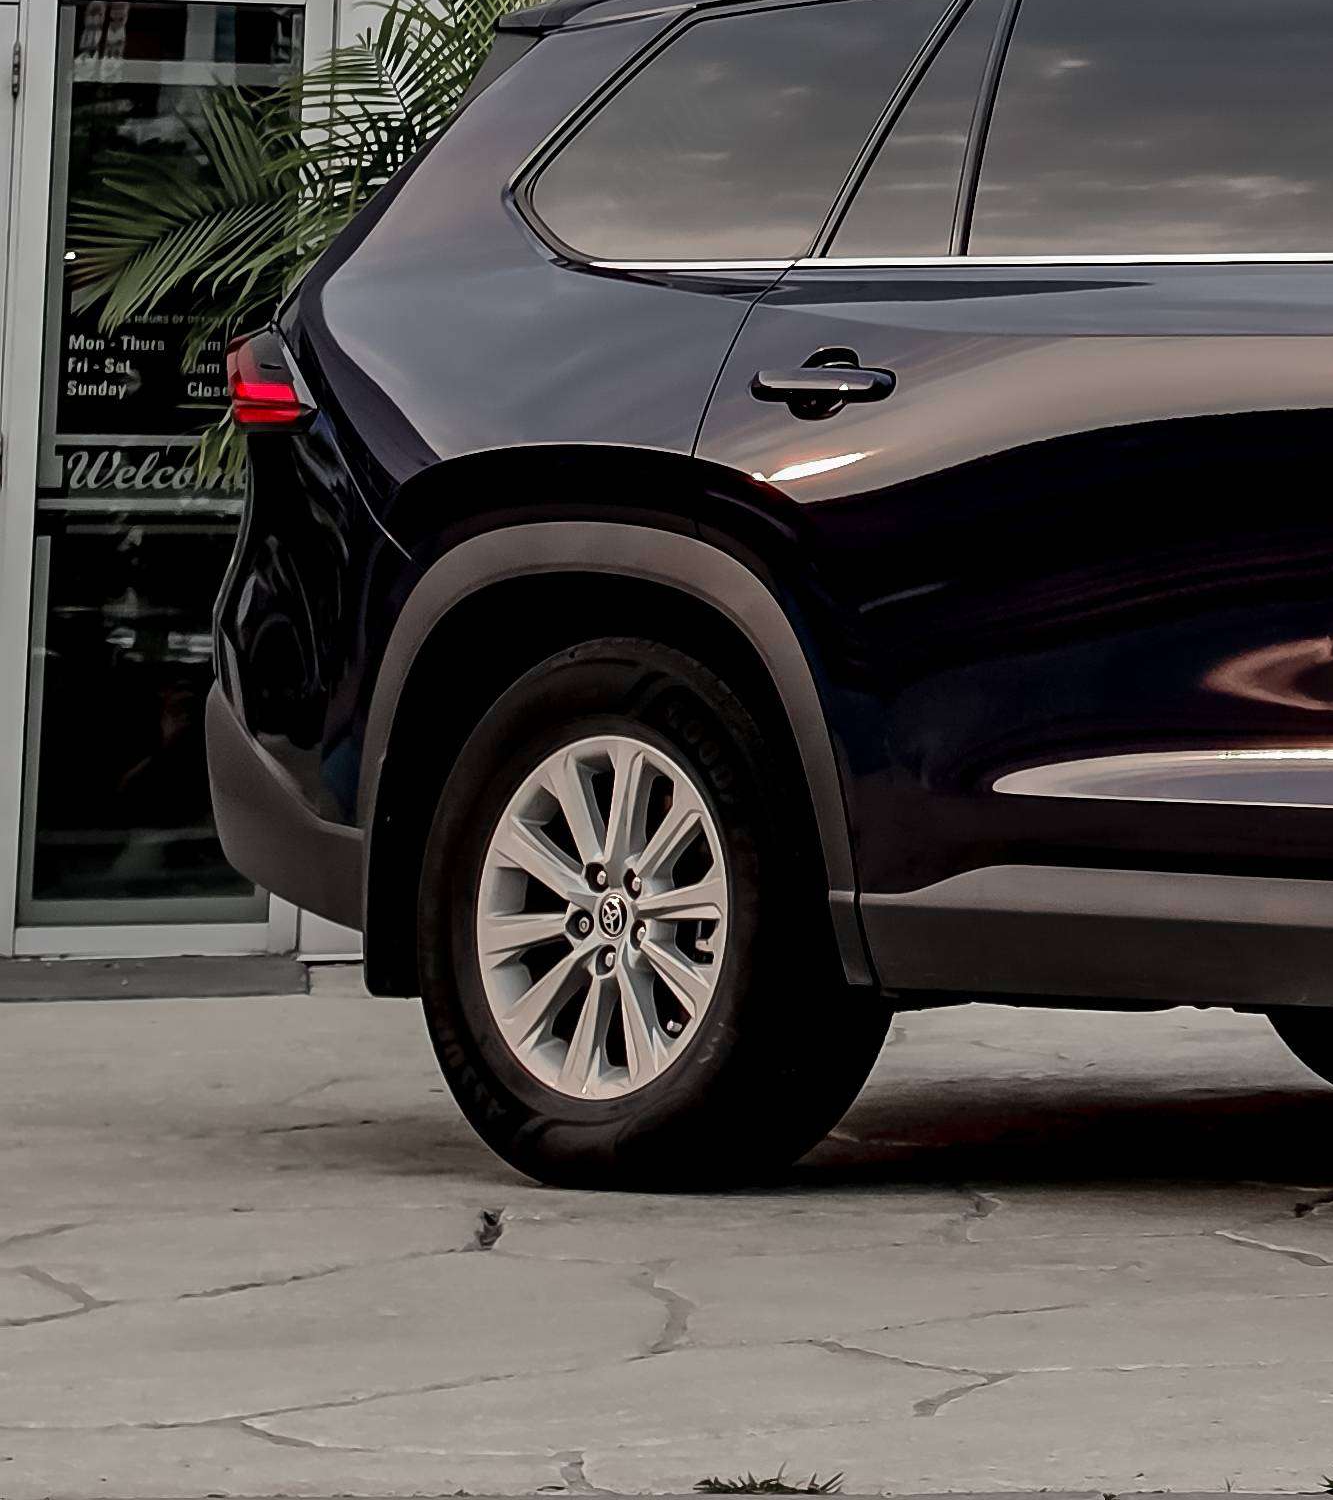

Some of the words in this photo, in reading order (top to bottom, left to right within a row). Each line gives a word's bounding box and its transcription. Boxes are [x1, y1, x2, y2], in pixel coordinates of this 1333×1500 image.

[68, 333, 105, 351] Mon
[67, 356, 88, 373] Fri
[104, 357, 131, 374] Sat
[67, 379, 127, 400] Sunday
